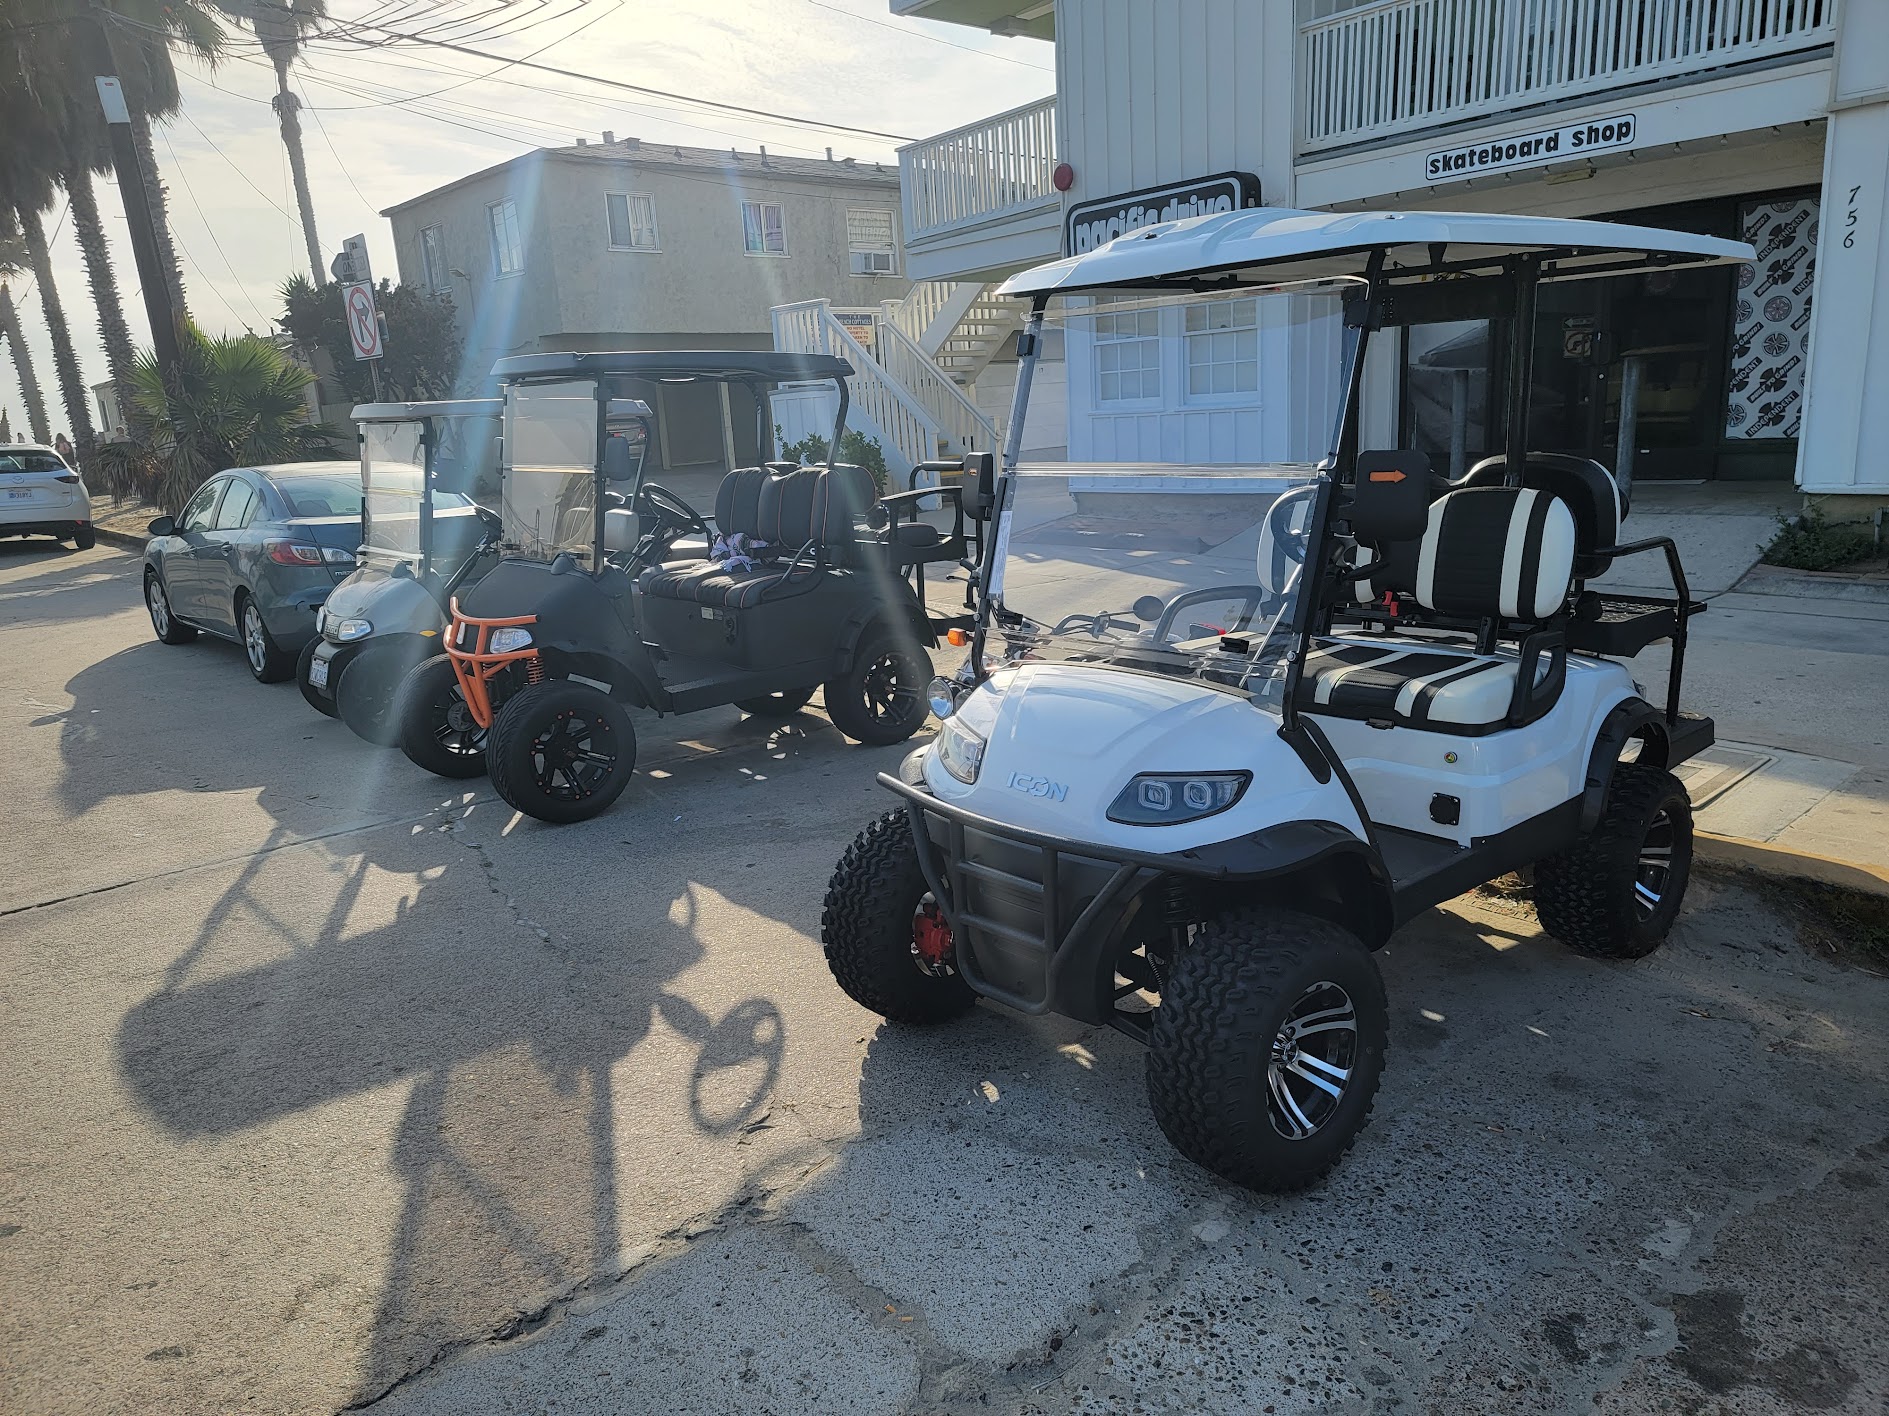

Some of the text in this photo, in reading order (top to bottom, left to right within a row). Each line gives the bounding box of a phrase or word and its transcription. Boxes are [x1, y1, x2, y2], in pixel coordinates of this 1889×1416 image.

[1429, 120, 1632, 175] skateboard shop
[1758, 212, 1807, 260] INDEPENDENT
[1843, 185, 1862, 249] 756
[1750, 384, 1766, 403] BUILT
[1775, 356, 1798, 378] GRIND!
[1748, 393, 1795, 434] INDEPENDENT
[1006, 771, 1069, 803] ICON
